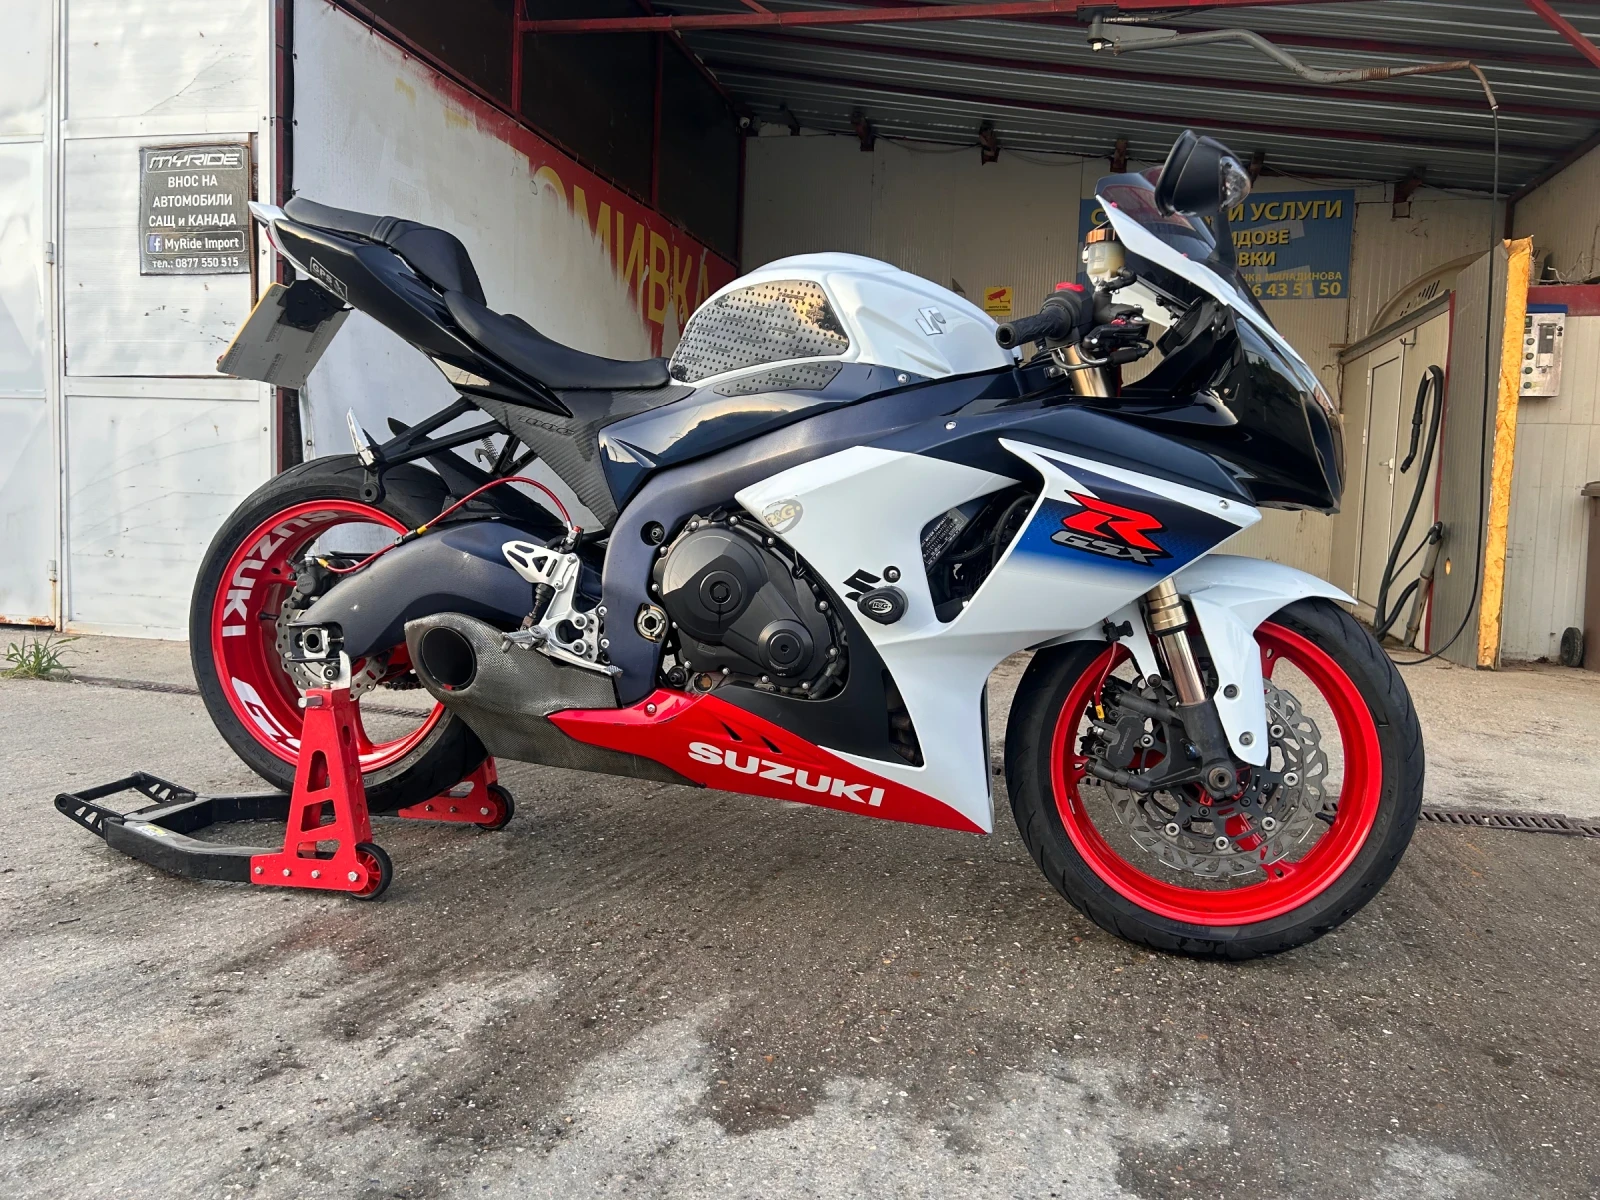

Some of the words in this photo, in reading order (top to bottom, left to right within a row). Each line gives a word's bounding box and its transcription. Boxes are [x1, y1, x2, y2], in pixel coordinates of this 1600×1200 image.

[168, 175, 199, 188] ВНОС
[202, 175, 218, 186] НА
[152, 194, 233, 208] АВТОМОБИЛИ
[1250, 200, 1343, 221] УСЛУГИ
[148, 215, 176, 228] САЩ
[178, 217, 186, 226] и
[188, 213, 237, 227] КАНАДА
[164, 238, 202, 251] MyRide
[204, 237, 240, 251] Import
[175, 258, 199, 268] 0877
[201, 257, 219, 267] 550
[221, 256, 239, 267] 515
[1265, 271, 1342, 281] МИЛАДИНОВА
[1266, 283, 1288, 297] 43
[1292, 283, 1313, 296] 51
[1319, 282, 1342, 296] 50
[1050, 530, 1163, 564] GSX
[222, 510, 339, 637] SUZUKI
[688, 741, 885, 807] SUZUKI
